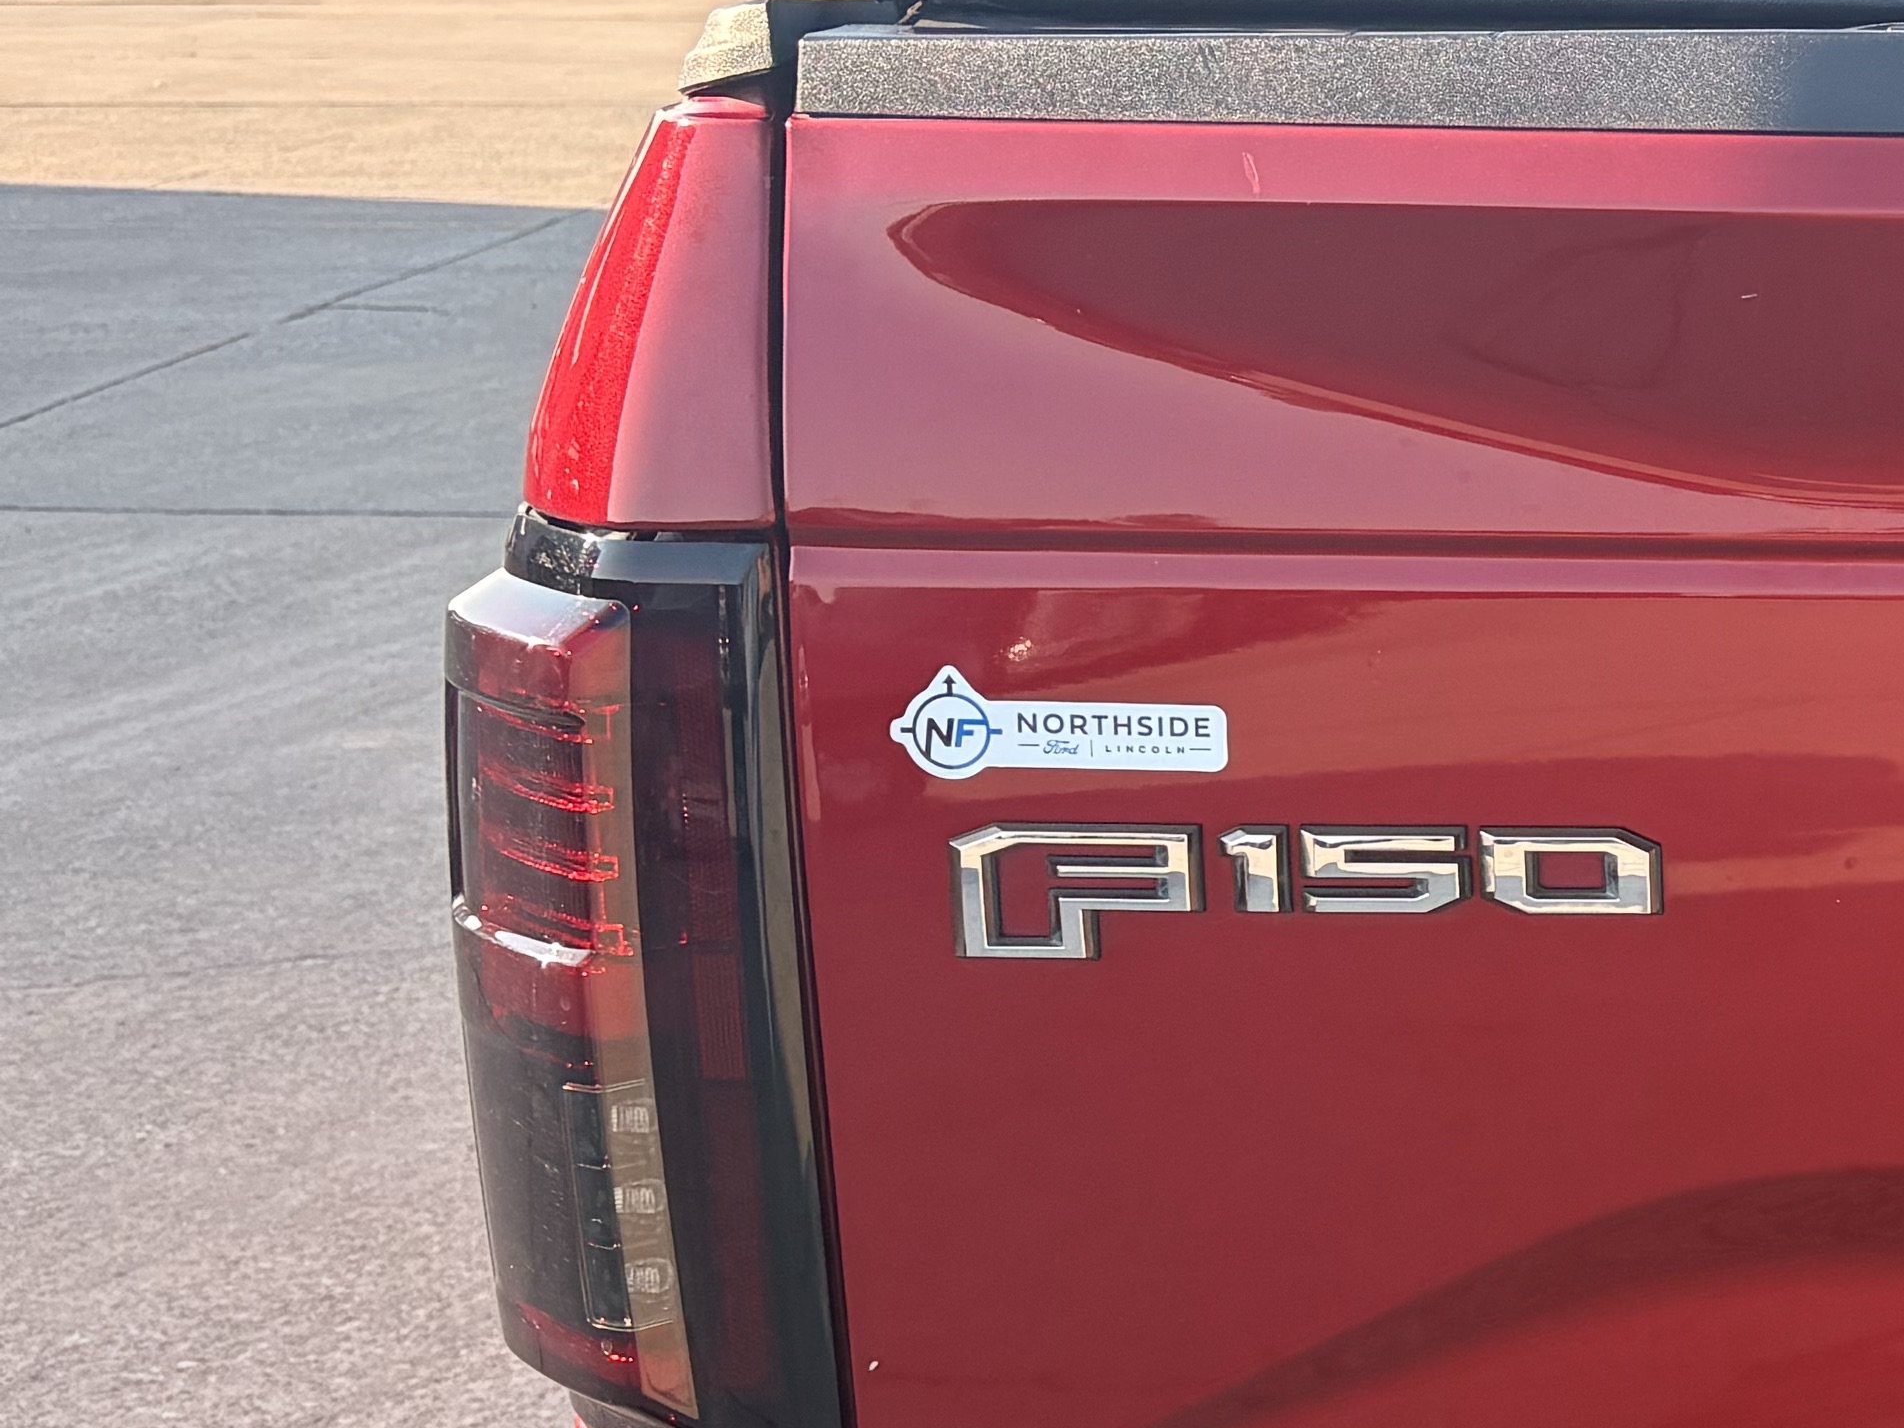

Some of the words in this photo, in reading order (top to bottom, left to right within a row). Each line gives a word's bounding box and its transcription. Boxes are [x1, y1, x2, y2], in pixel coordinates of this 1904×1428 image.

[926, 717, 989, 759] NF
[1017, 711, 1211, 739] NORTHSIDE
[1043, 739, 1080, 755] Ford
[1105, 744, 1186, 755] LINCOLN
